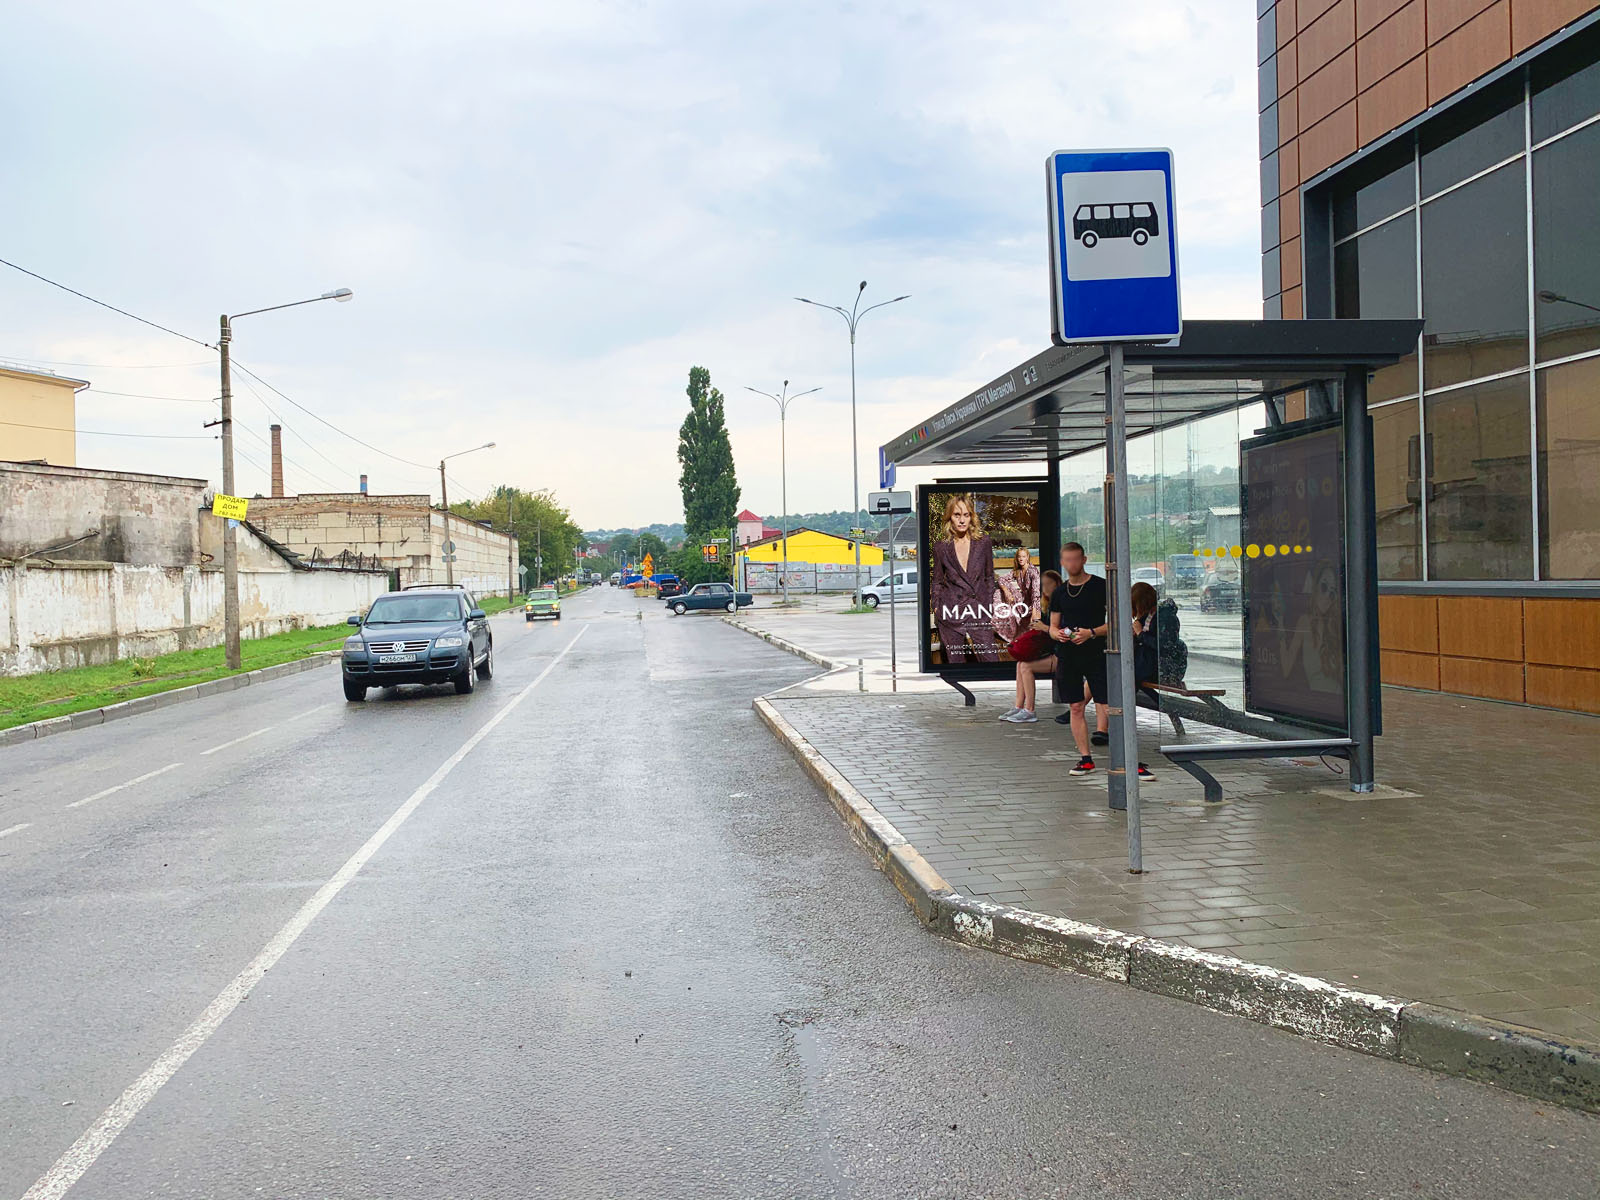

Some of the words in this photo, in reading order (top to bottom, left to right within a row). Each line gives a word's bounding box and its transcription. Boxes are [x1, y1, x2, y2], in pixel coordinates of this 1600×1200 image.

[954, 401, 977, 422] Украинки
[974, 391, 990, 411] (ТРК
[987, 375, 1016, 402] Меганом)
[218, 494, 246, 504] ПРОДАМ
[942, 602, 1029, 621] MANGO
